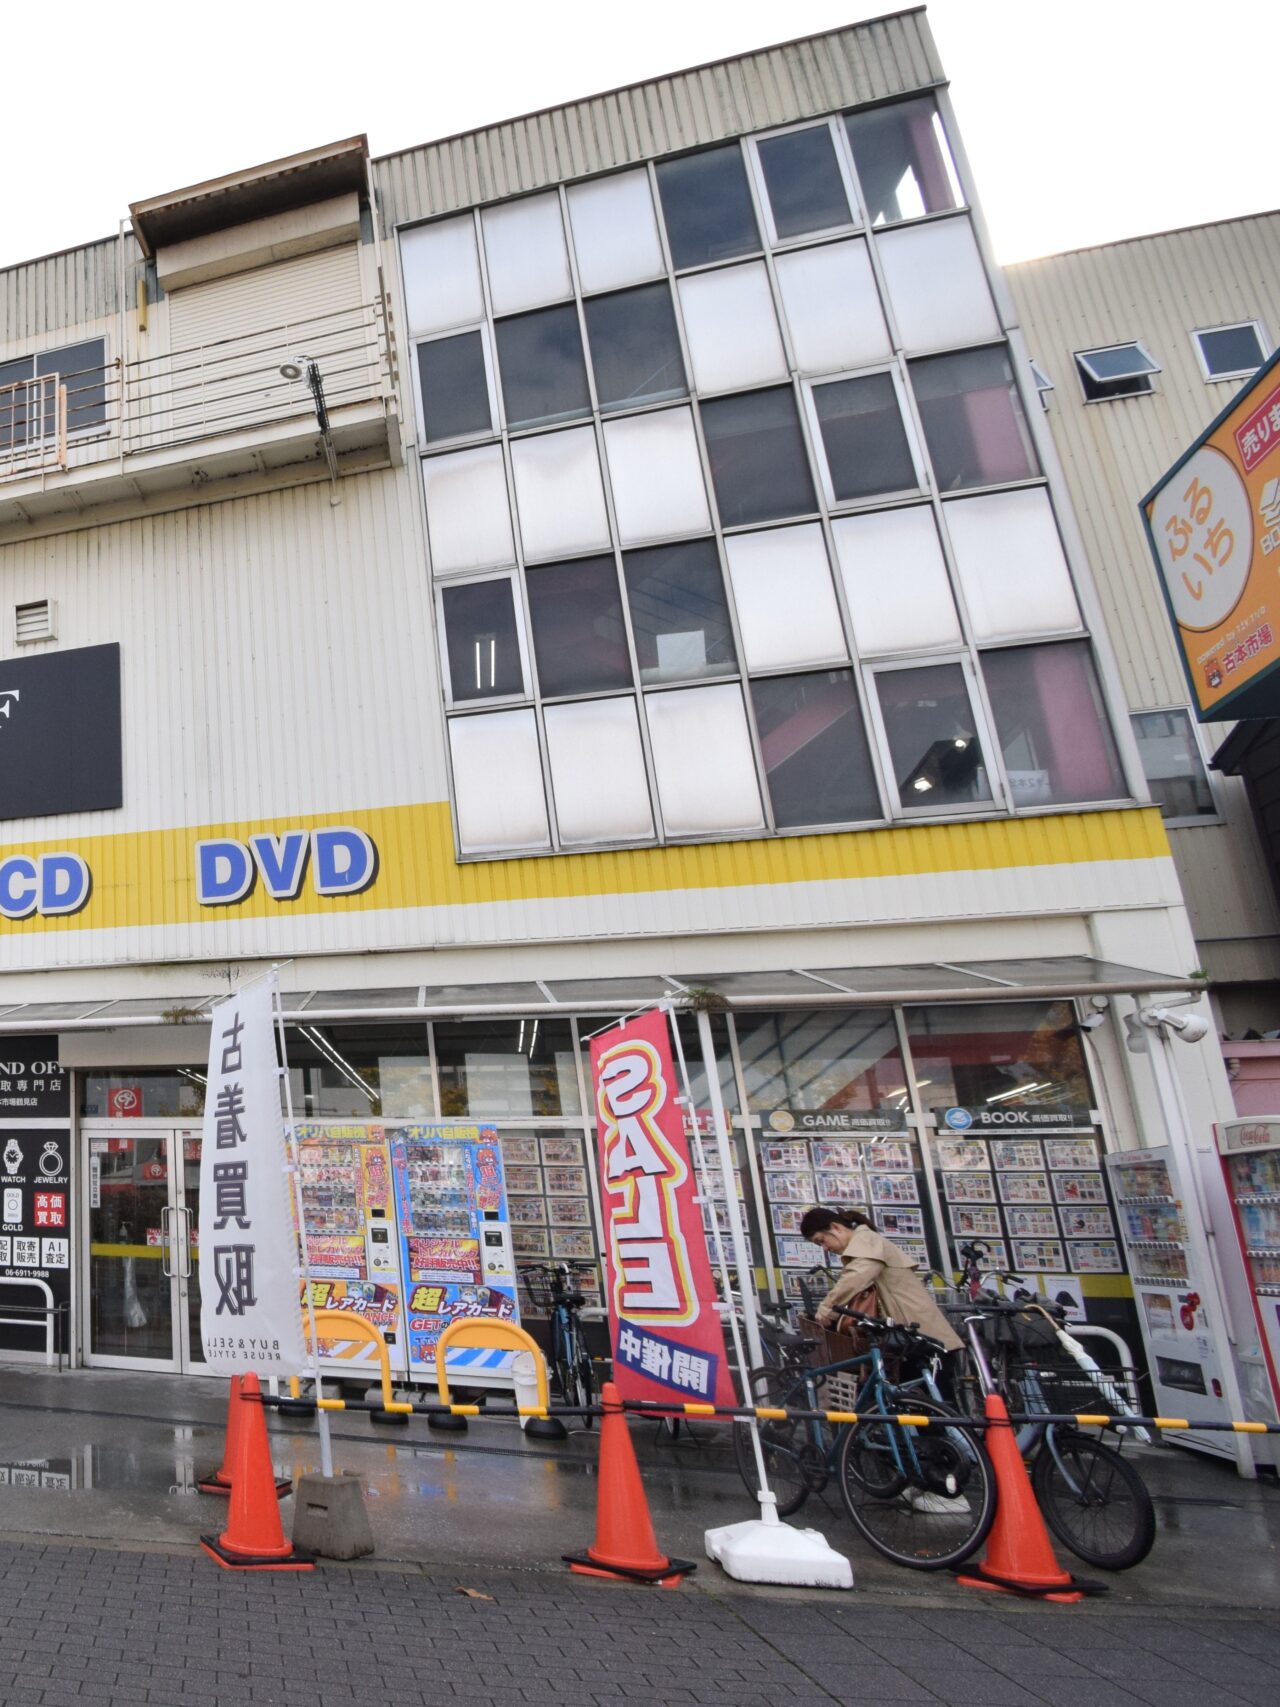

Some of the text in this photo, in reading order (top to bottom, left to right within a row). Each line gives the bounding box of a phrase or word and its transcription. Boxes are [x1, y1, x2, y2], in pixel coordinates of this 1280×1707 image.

[1165, 477, 1213, 562] ふる
[1182, 517, 1234, 602] いち
[1222, 623, 1274, 675] 古本市場
[195, 825, 378, 907] DVD
[802, 1114, 849, 1127] GAME
[980, 1111, 1031, 1124] BOOK
[0, 1175, 26, 1184] WATCH
[33, 1176, 69, 1184] JEWELRY
[37, 1194, 63, 1208] 高価
[37, 1211, 63, 1225] 買取
[2, 1223, 24, 1232] GOLD
[16, 1240, 36, 1252] 取寄
[16, 1251, 36, 1264] 販売
[45, 1252, 65, 1265] 査定
